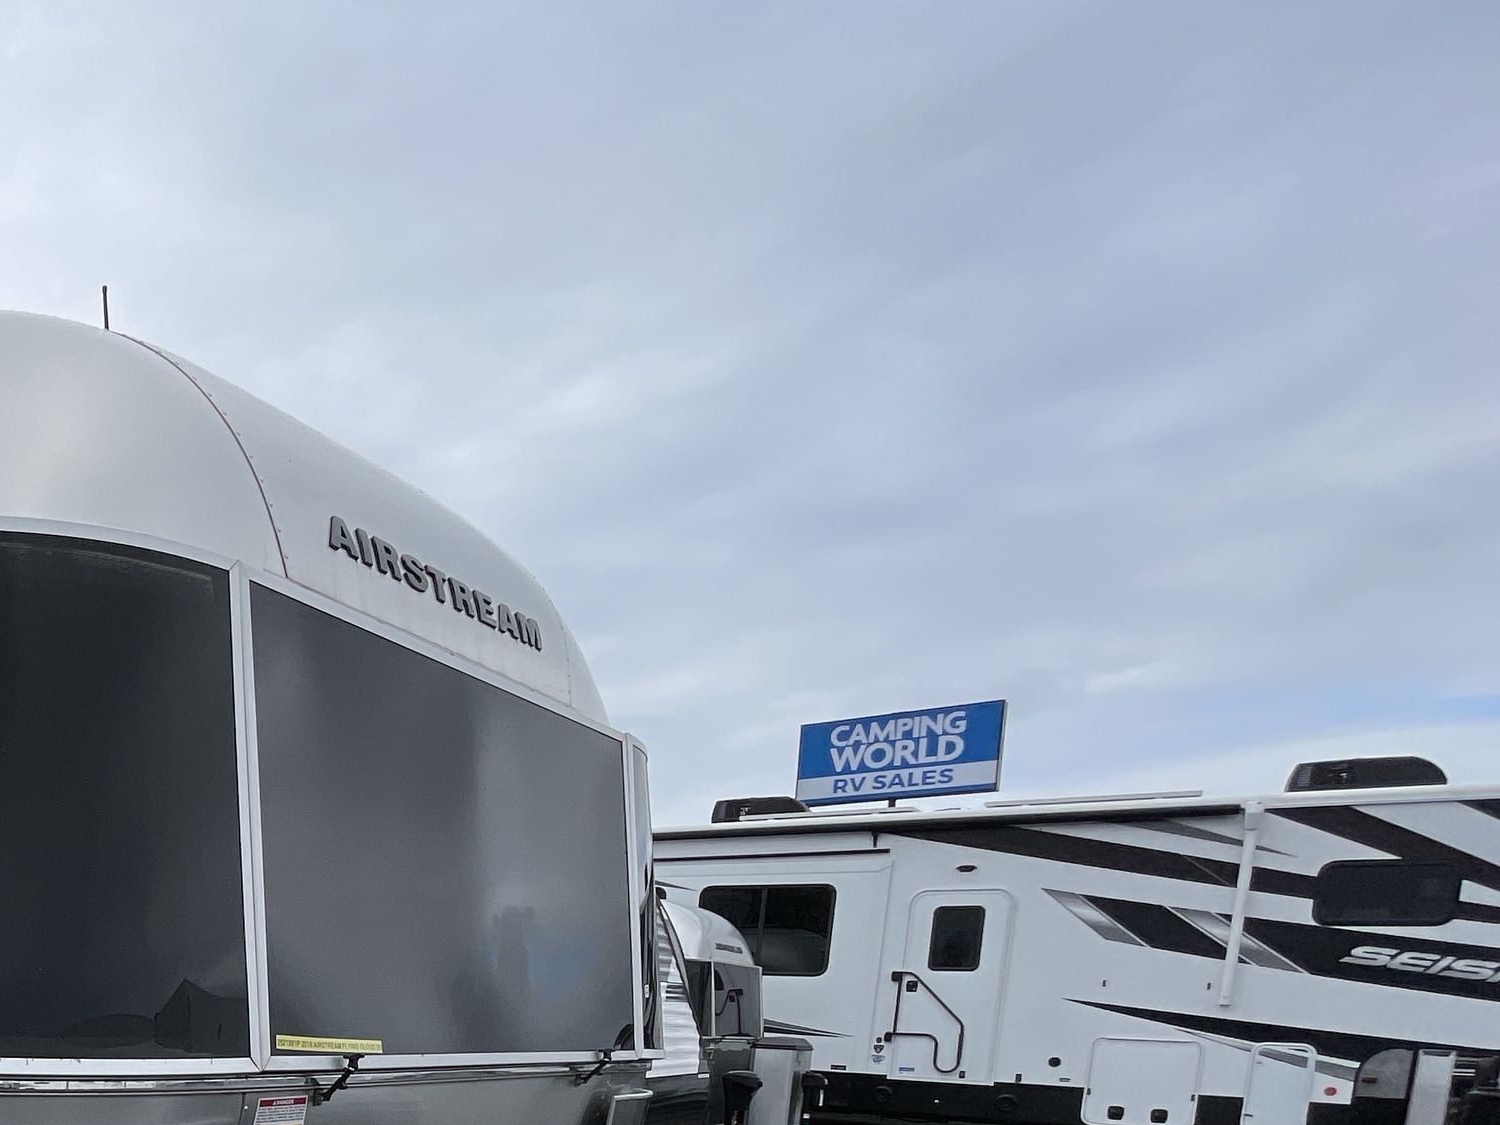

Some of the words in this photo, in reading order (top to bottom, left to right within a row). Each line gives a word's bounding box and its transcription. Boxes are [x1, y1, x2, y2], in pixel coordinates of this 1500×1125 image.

[329, 515, 542, 652] AIRSTREAM
[830, 711, 967, 747] CAMPING
[829, 735, 965, 773] WORLD
[833, 776, 867, 794] RV
[872, 768, 954, 790] SALES
[1338, 945, 1500, 983] SEIS
